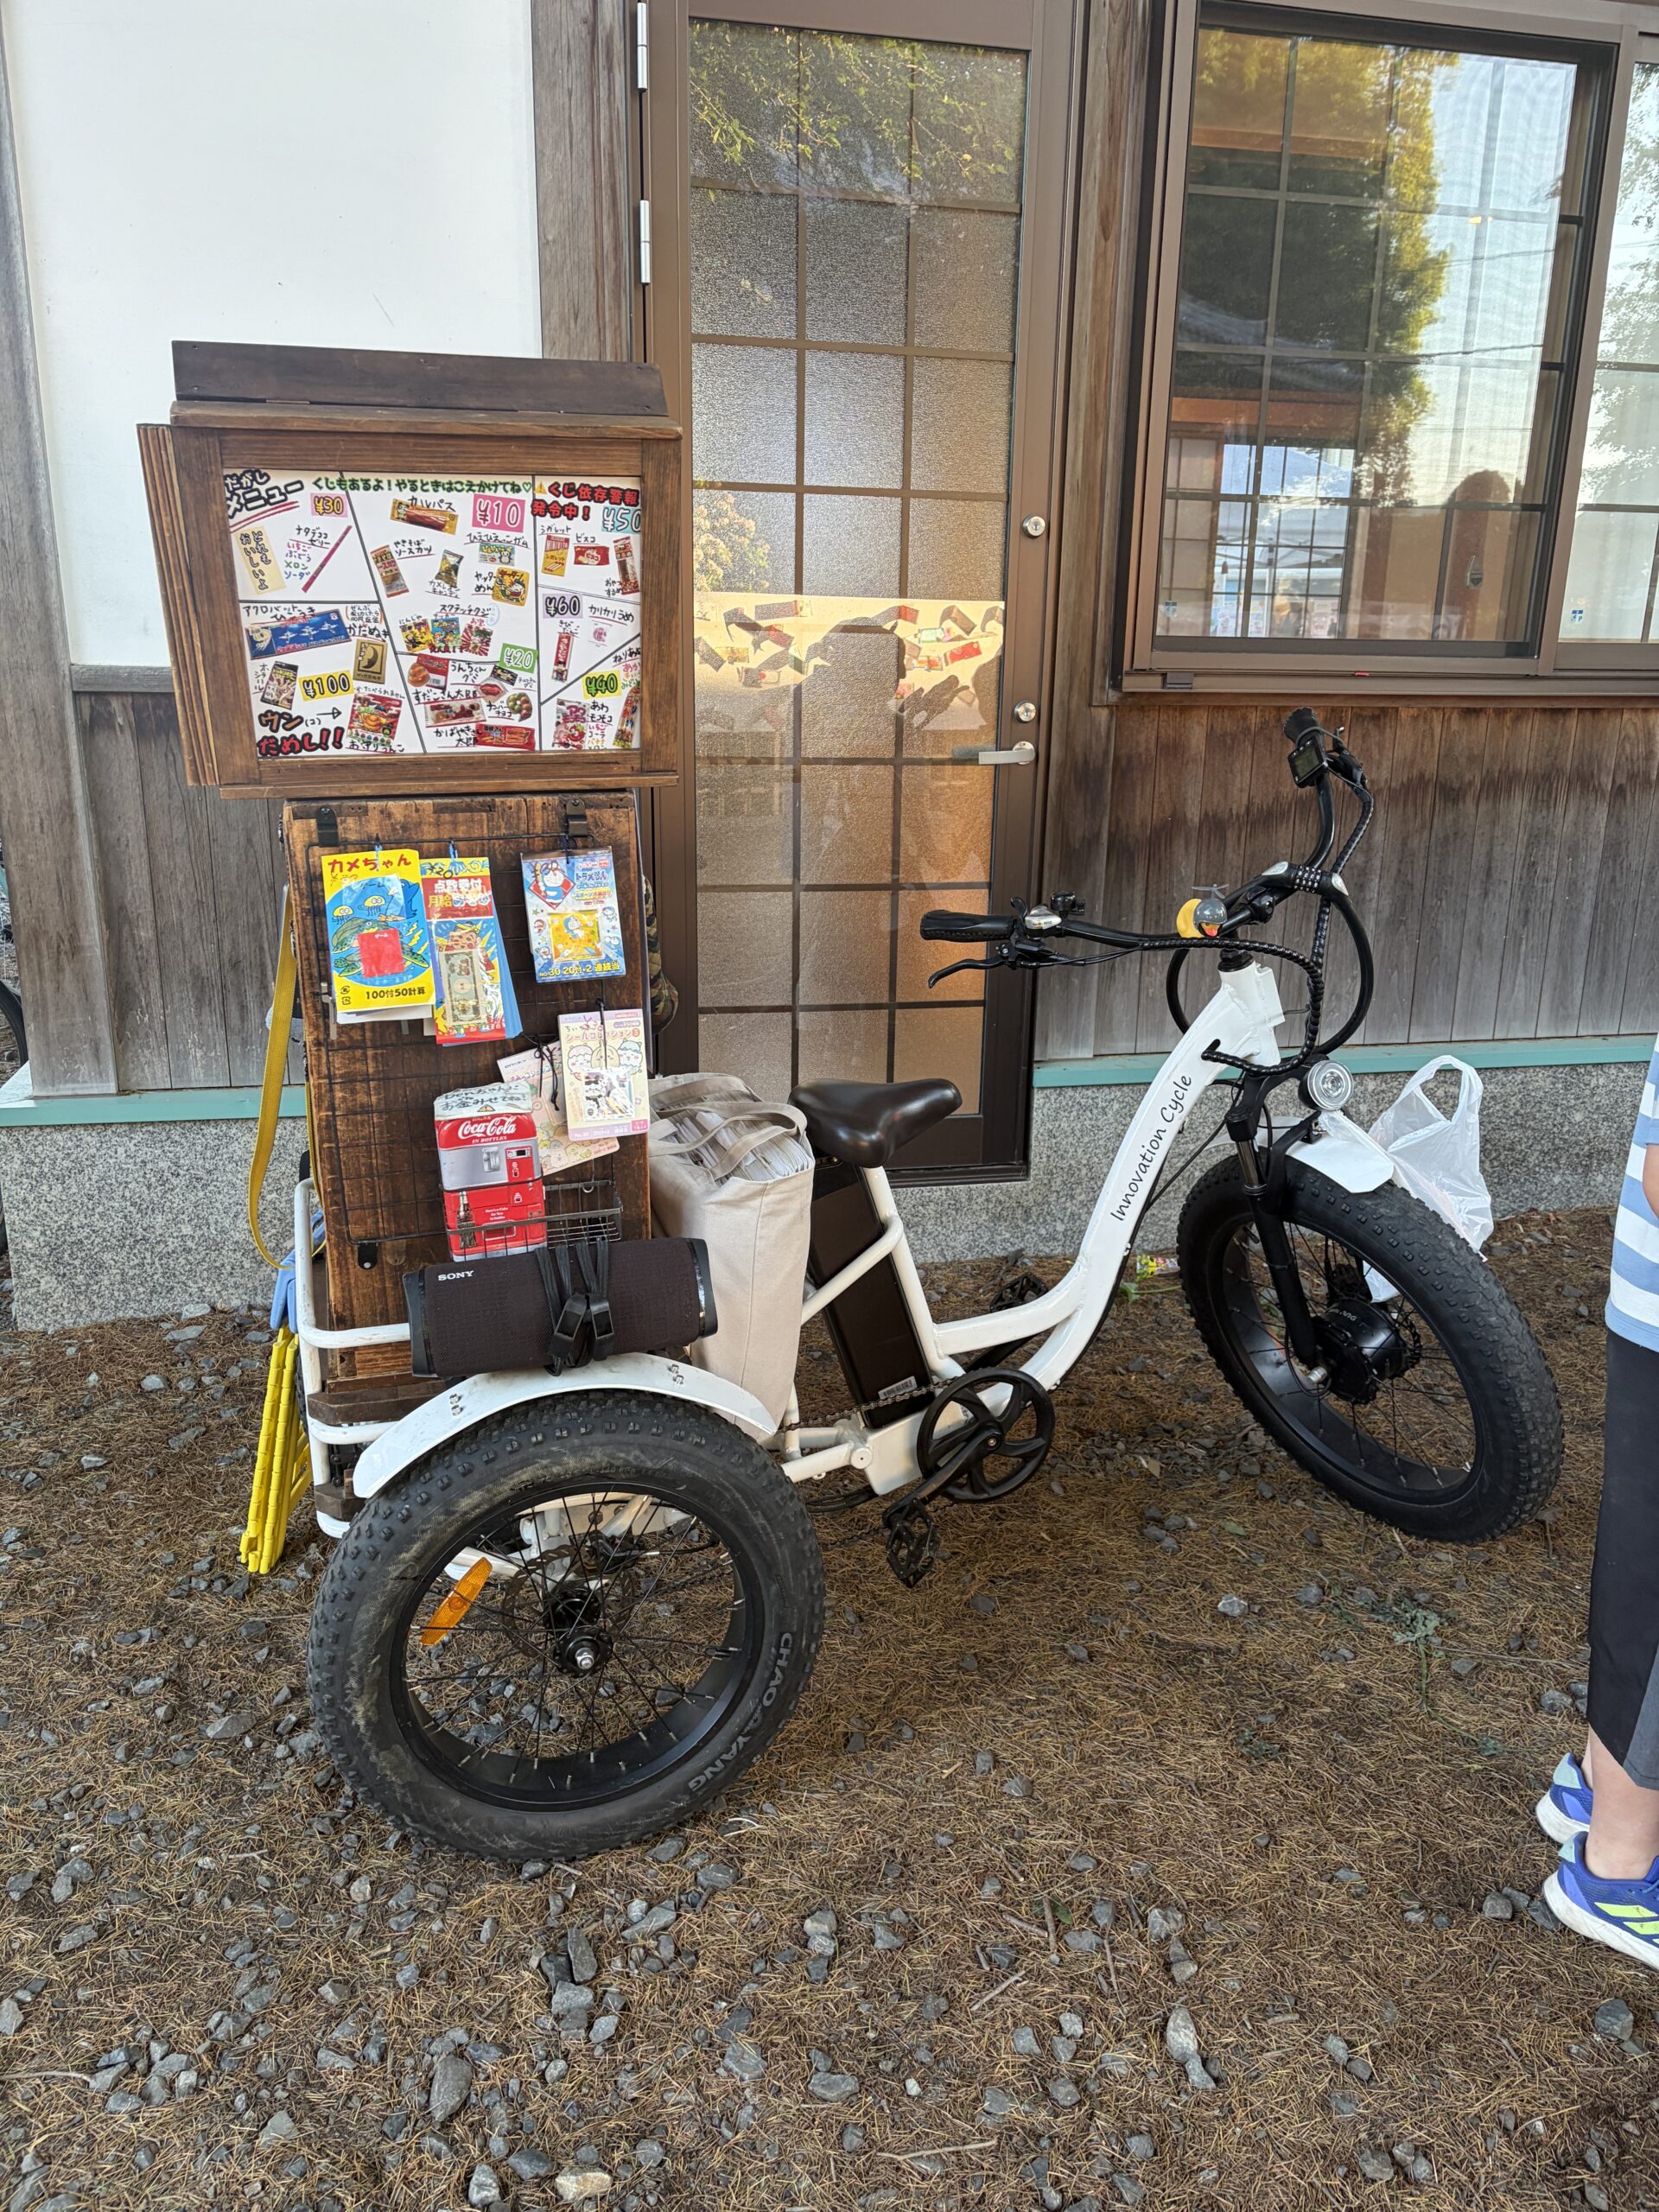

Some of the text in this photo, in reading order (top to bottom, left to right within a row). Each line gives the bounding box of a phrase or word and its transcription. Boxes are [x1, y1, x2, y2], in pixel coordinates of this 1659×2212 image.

[224, 469, 270, 493] だがし
[226, 480, 304, 519] メニュー
[548, 481, 639, 507] くじ依存警報
[314, 495, 345, 517] ¥30
[475, 498, 522, 529] ¥10
[531, 499, 591, 522] 発令中！
[602, 506, 640, 532] ¥50
[287, 542, 312, 552] いちご
[393, 538, 426, 549] やきそば
[575, 532, 596, 543] ビスコ
[239, 532, 269, 590] おいしいよ
[284, 560, 309, 571] メロン
[284, 570, 311, 581] ソーダ
[439, 604, 492, 619] スクラッチクジ
[544, 595, 581, 618] ¥60
[588, 604, 635, 623] カリカリうめ
[451, 662, 486, 672] うんちくん
[504, 648, 534, 669] ¥20
[302, 672, 351, 700] ¥100
[585, 672, 619, 697] ¥40
[590, 699, 609, 713] あわ
[589, 713, 613, 724] モコモコ
[327, 854, 412, 873] カメちゃん
[365, 986, 426, 1001] 100付50計算
[458, 1116, 518, 1140] Coca-Cola
[483, 1135, 508, 1144] BOTTLES
[1110, 1075, 1192, 1222] Innovation Cycle
[437, 1270, 474, 1281] SONY
[688, 1631, 793, 1792] CHAO YANG
